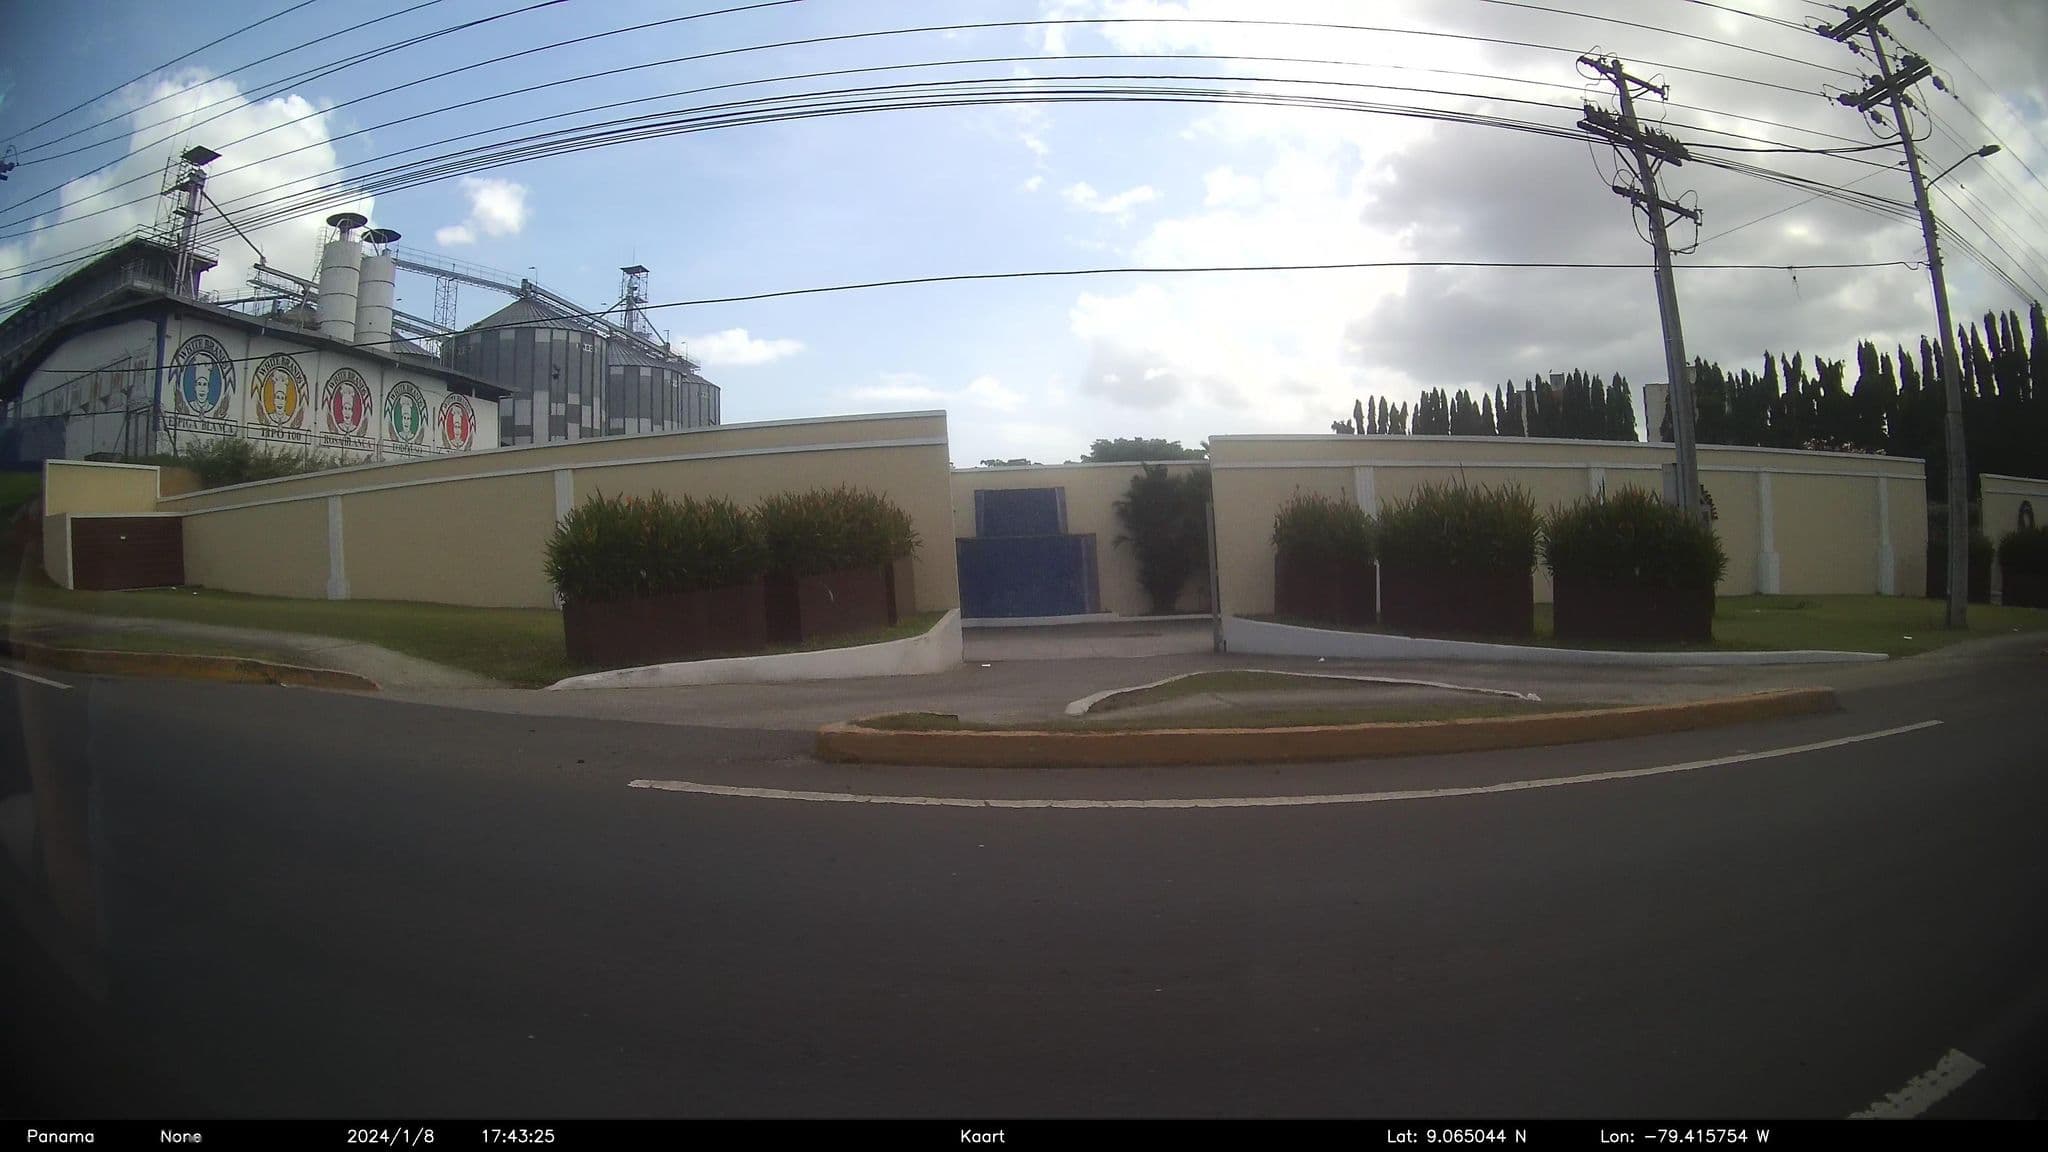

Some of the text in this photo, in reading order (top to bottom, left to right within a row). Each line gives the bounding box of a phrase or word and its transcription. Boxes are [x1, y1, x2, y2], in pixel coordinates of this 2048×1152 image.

[179, 338, 203, 361] WHITE
[258, 356, 280, 376] WHITE
[329, 371, 346, 389] WHITE
